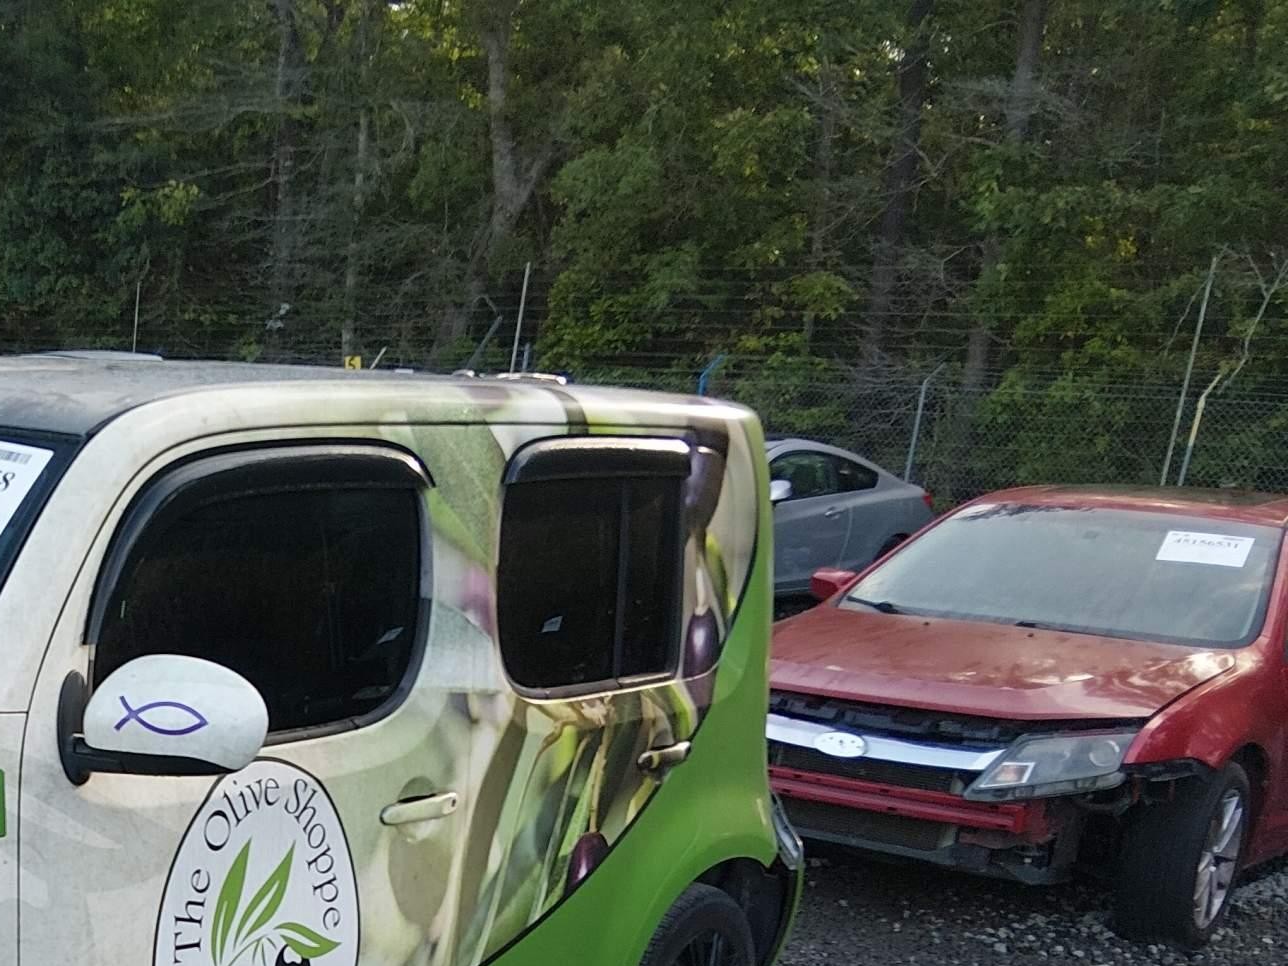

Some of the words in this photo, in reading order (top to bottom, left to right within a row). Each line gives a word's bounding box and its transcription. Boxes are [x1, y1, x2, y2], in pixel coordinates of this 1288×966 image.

[174, 868, 211, 964] The
[204, 777, 280, 851] Olive
[284, 778, 341, 930] Shoppe
